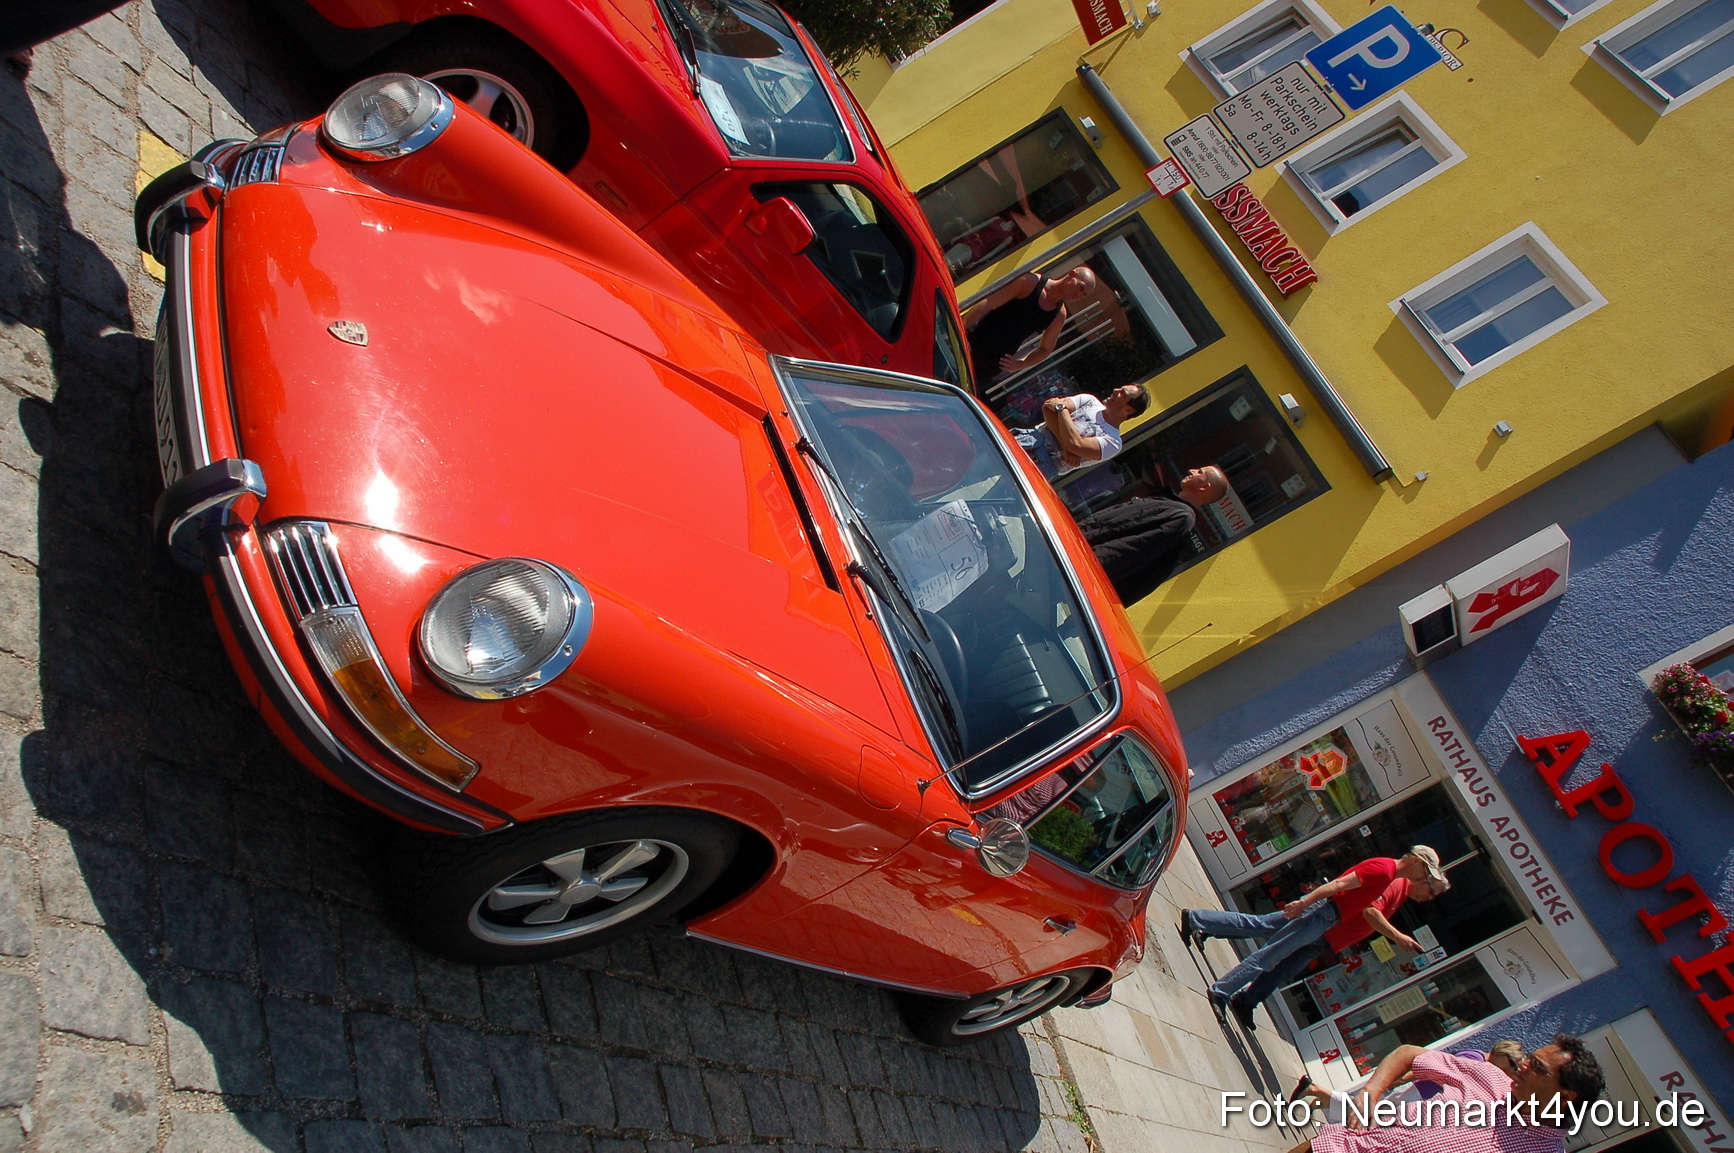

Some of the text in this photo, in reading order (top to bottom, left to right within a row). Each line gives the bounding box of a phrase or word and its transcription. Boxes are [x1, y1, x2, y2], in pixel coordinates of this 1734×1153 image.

[1089, 0, 1114, 36] SMACH
[1327, 24, 1410, 69] P
[1223, 103, 1237, 118] Sa
[1237, 94, 1264, 123] Mo-Fr
[1260, 90, 1300, 136] werktags
[1269, 76, 1318, 132] Parkschein
[1290, 77, 1328, 115] nur mit
[1211, 183, 1318, 296] SSMACH
[1219, 496, 1247, 531] MACH
[950, 556, 974, 581] 56
[1427, 715, 1575, 927] RATHAUS APOTHEKE
[1516, 729, 1734, 1047] APOTH
